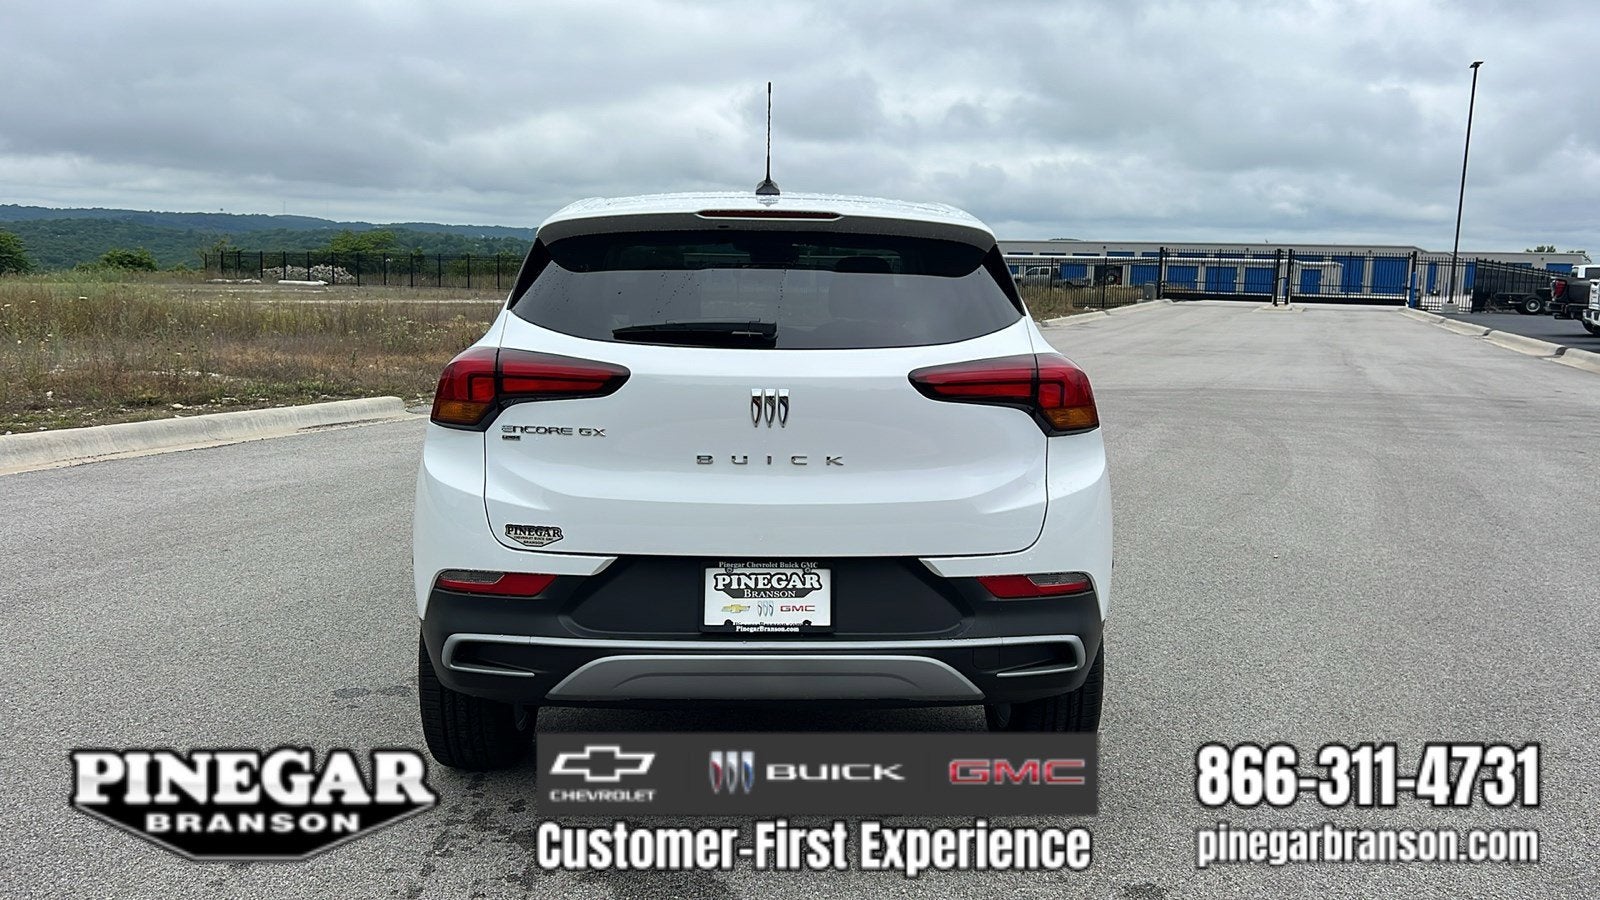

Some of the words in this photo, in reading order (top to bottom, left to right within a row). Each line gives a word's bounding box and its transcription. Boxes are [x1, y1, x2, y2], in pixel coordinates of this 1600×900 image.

[578, 427, 606, 437] GX
[696, 455, 844, 466] BUICK
[507, 526, 561, 538] PINEGAR
[719, 561, 744, 569] Pinegar
[715, 573, 821, 589] PINEGAR
[744, 589, 796, 598] BRANSON
